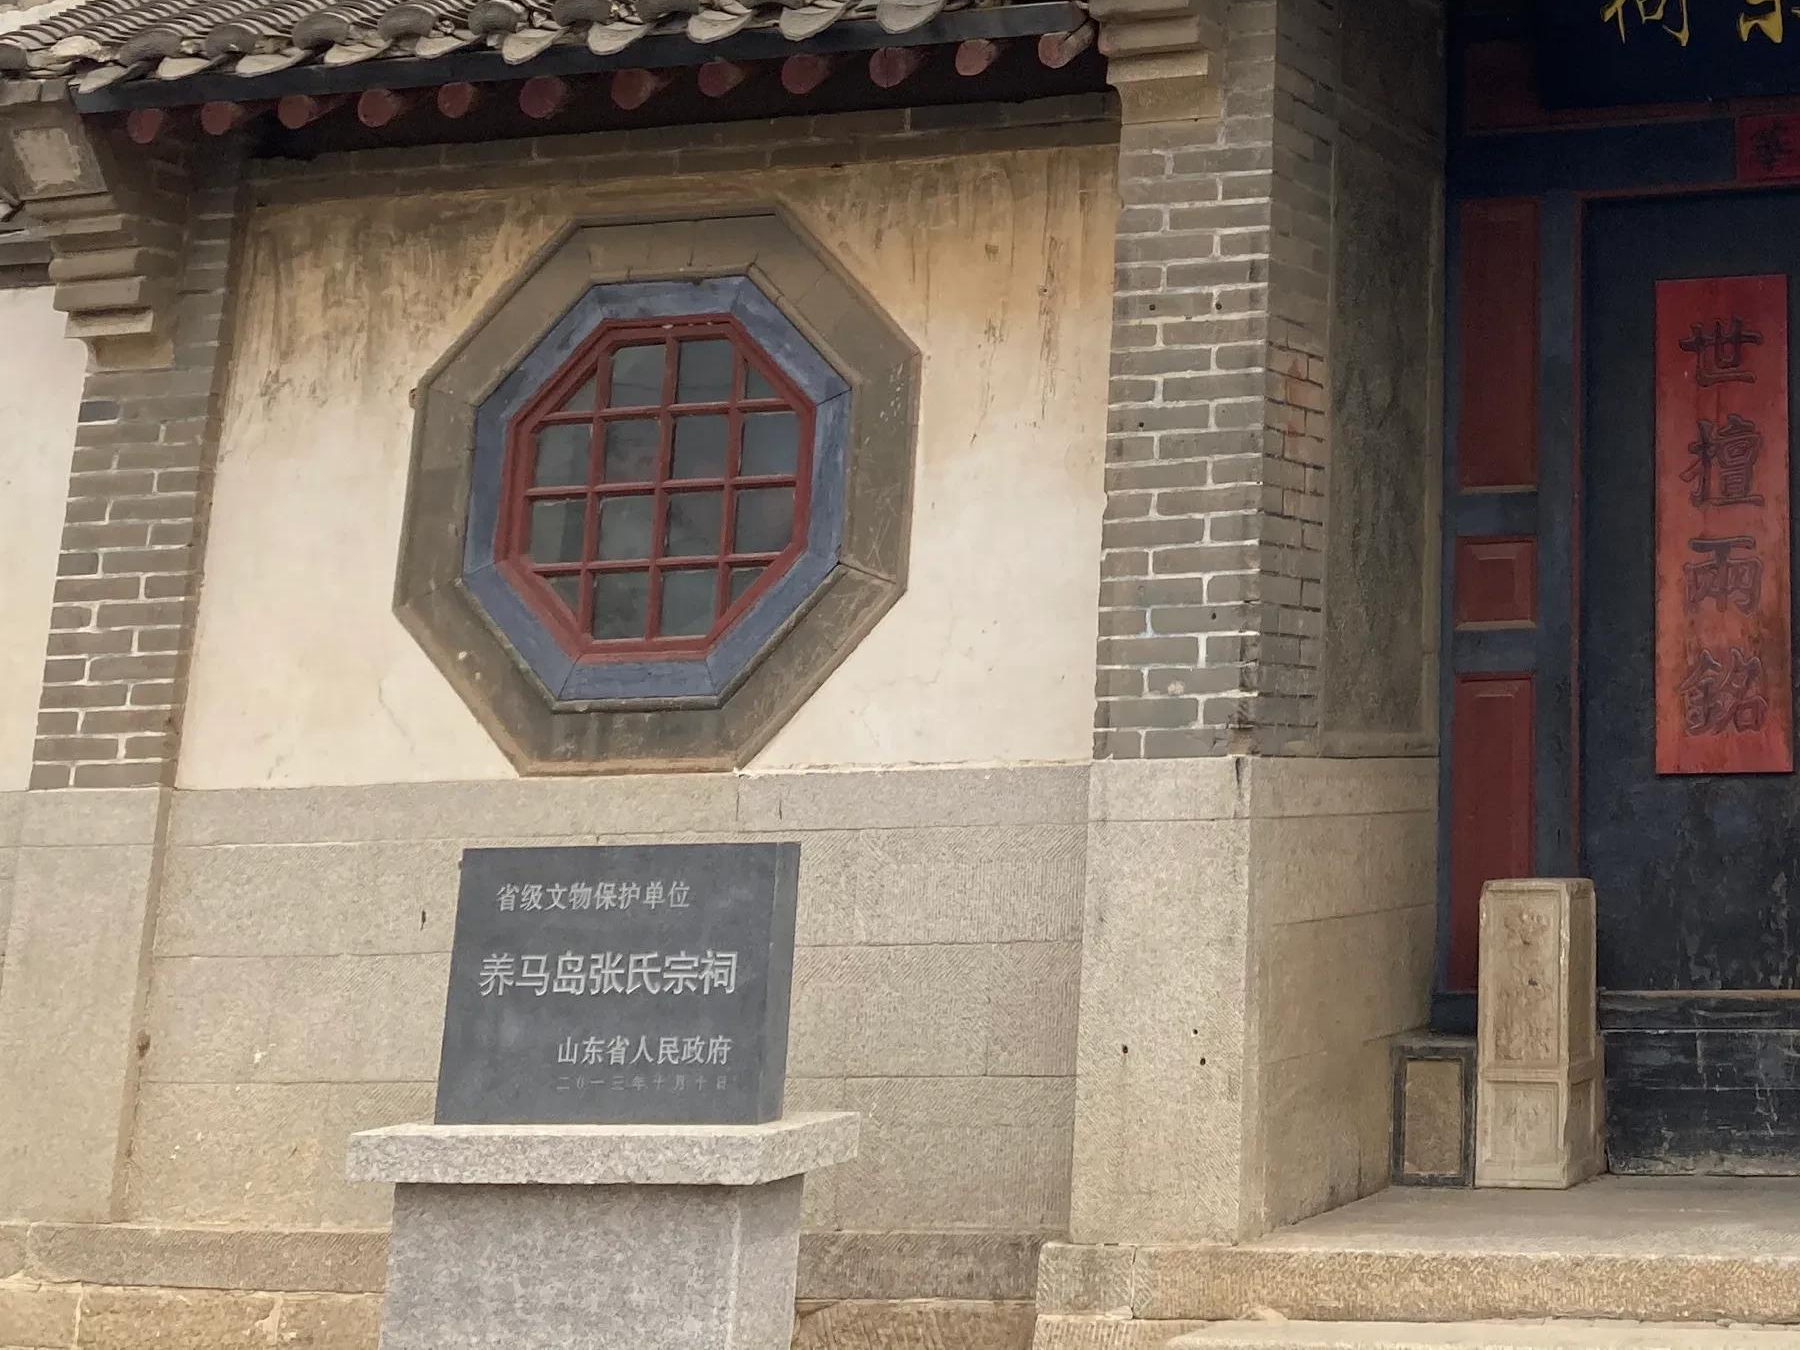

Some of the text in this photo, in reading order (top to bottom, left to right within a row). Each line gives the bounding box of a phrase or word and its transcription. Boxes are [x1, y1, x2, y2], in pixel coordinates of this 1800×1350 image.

[497, 880, 691, 912] 省级文物保护单位
[479, 950, 738, 996] 养马岛张氏宗祠
[557, 1035, 732, 1065] 山东省人民政府
